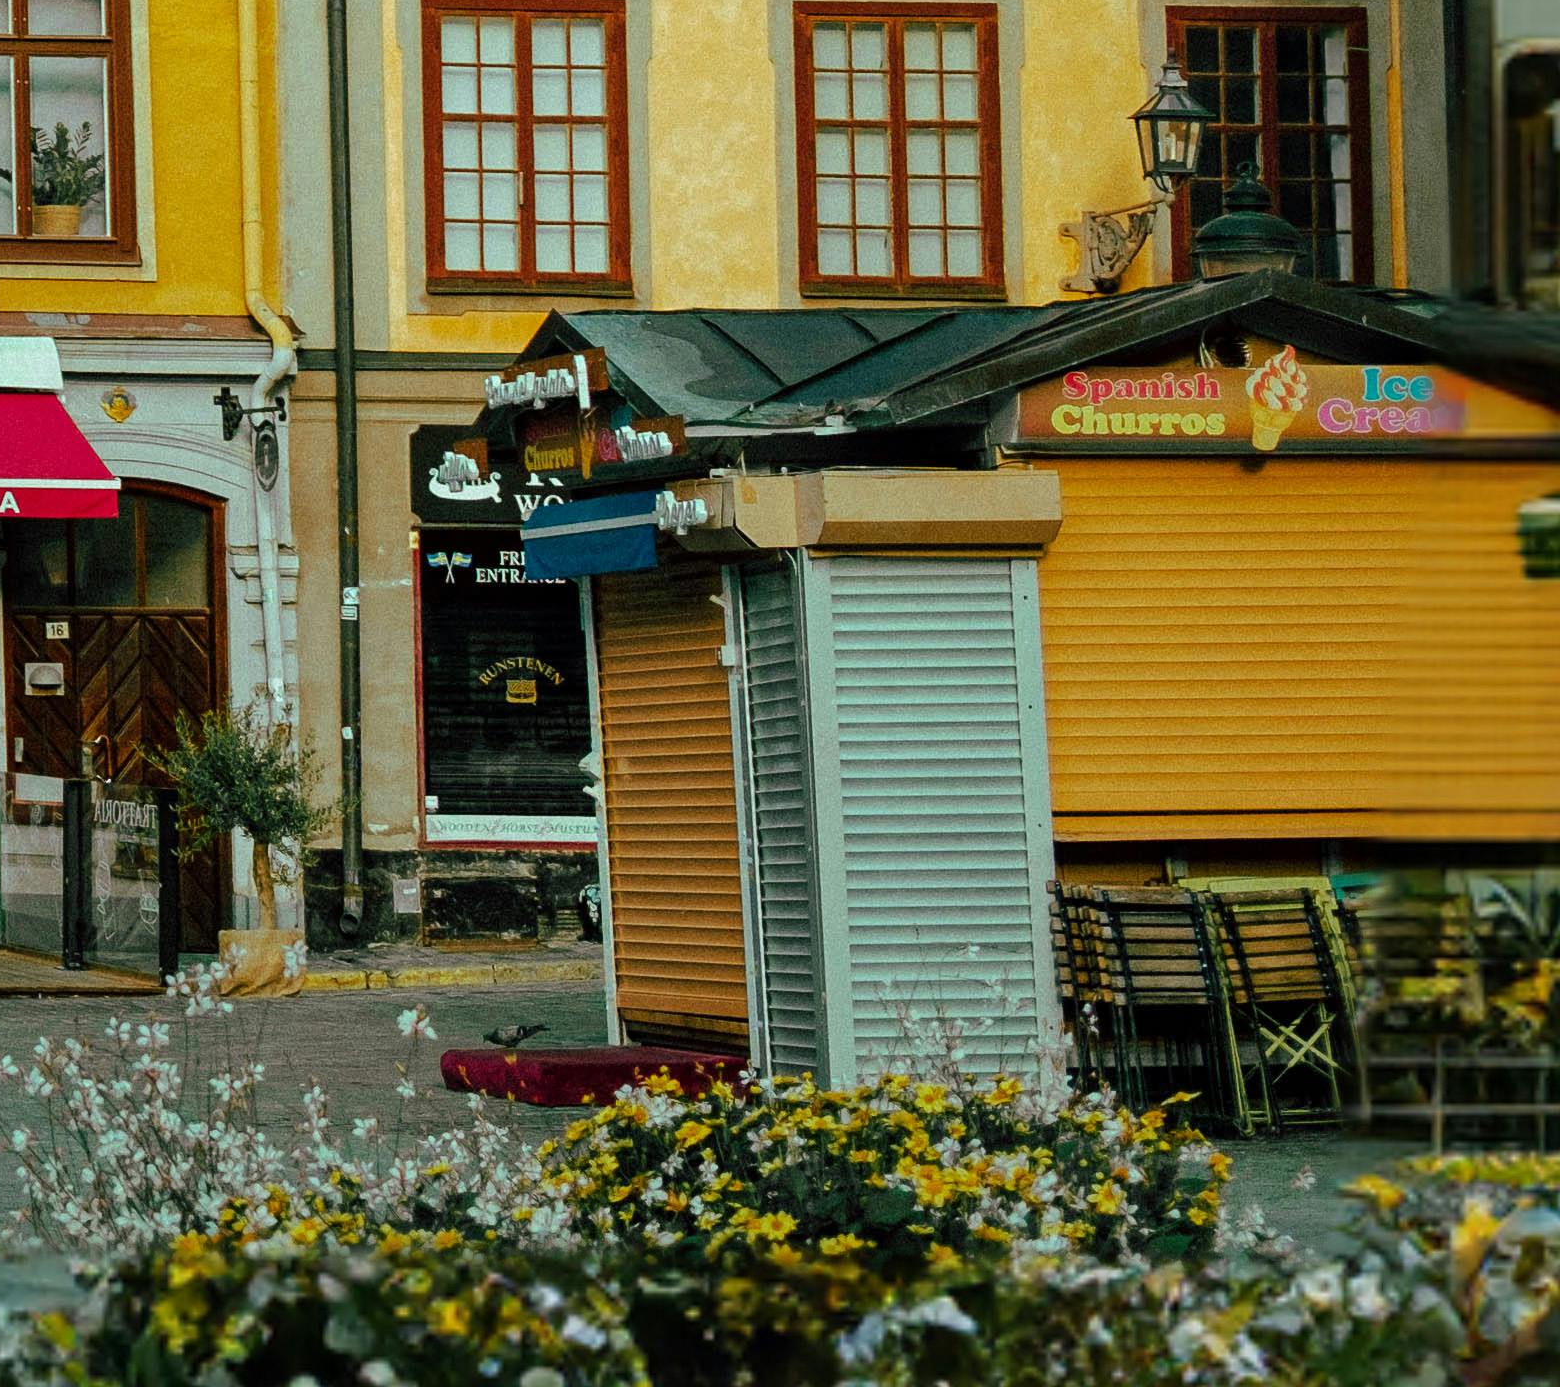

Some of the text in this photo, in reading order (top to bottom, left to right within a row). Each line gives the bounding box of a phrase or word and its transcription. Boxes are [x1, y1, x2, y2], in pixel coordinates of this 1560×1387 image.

[1061, 370, 1221, 404] Spanish
[1362, 366, 1434, 403] Ice
[1050, 404, 1226, 436] Churros
[51, 623, 64, 637] 16
[477, 656, 566, 686] RUNSTENEN
